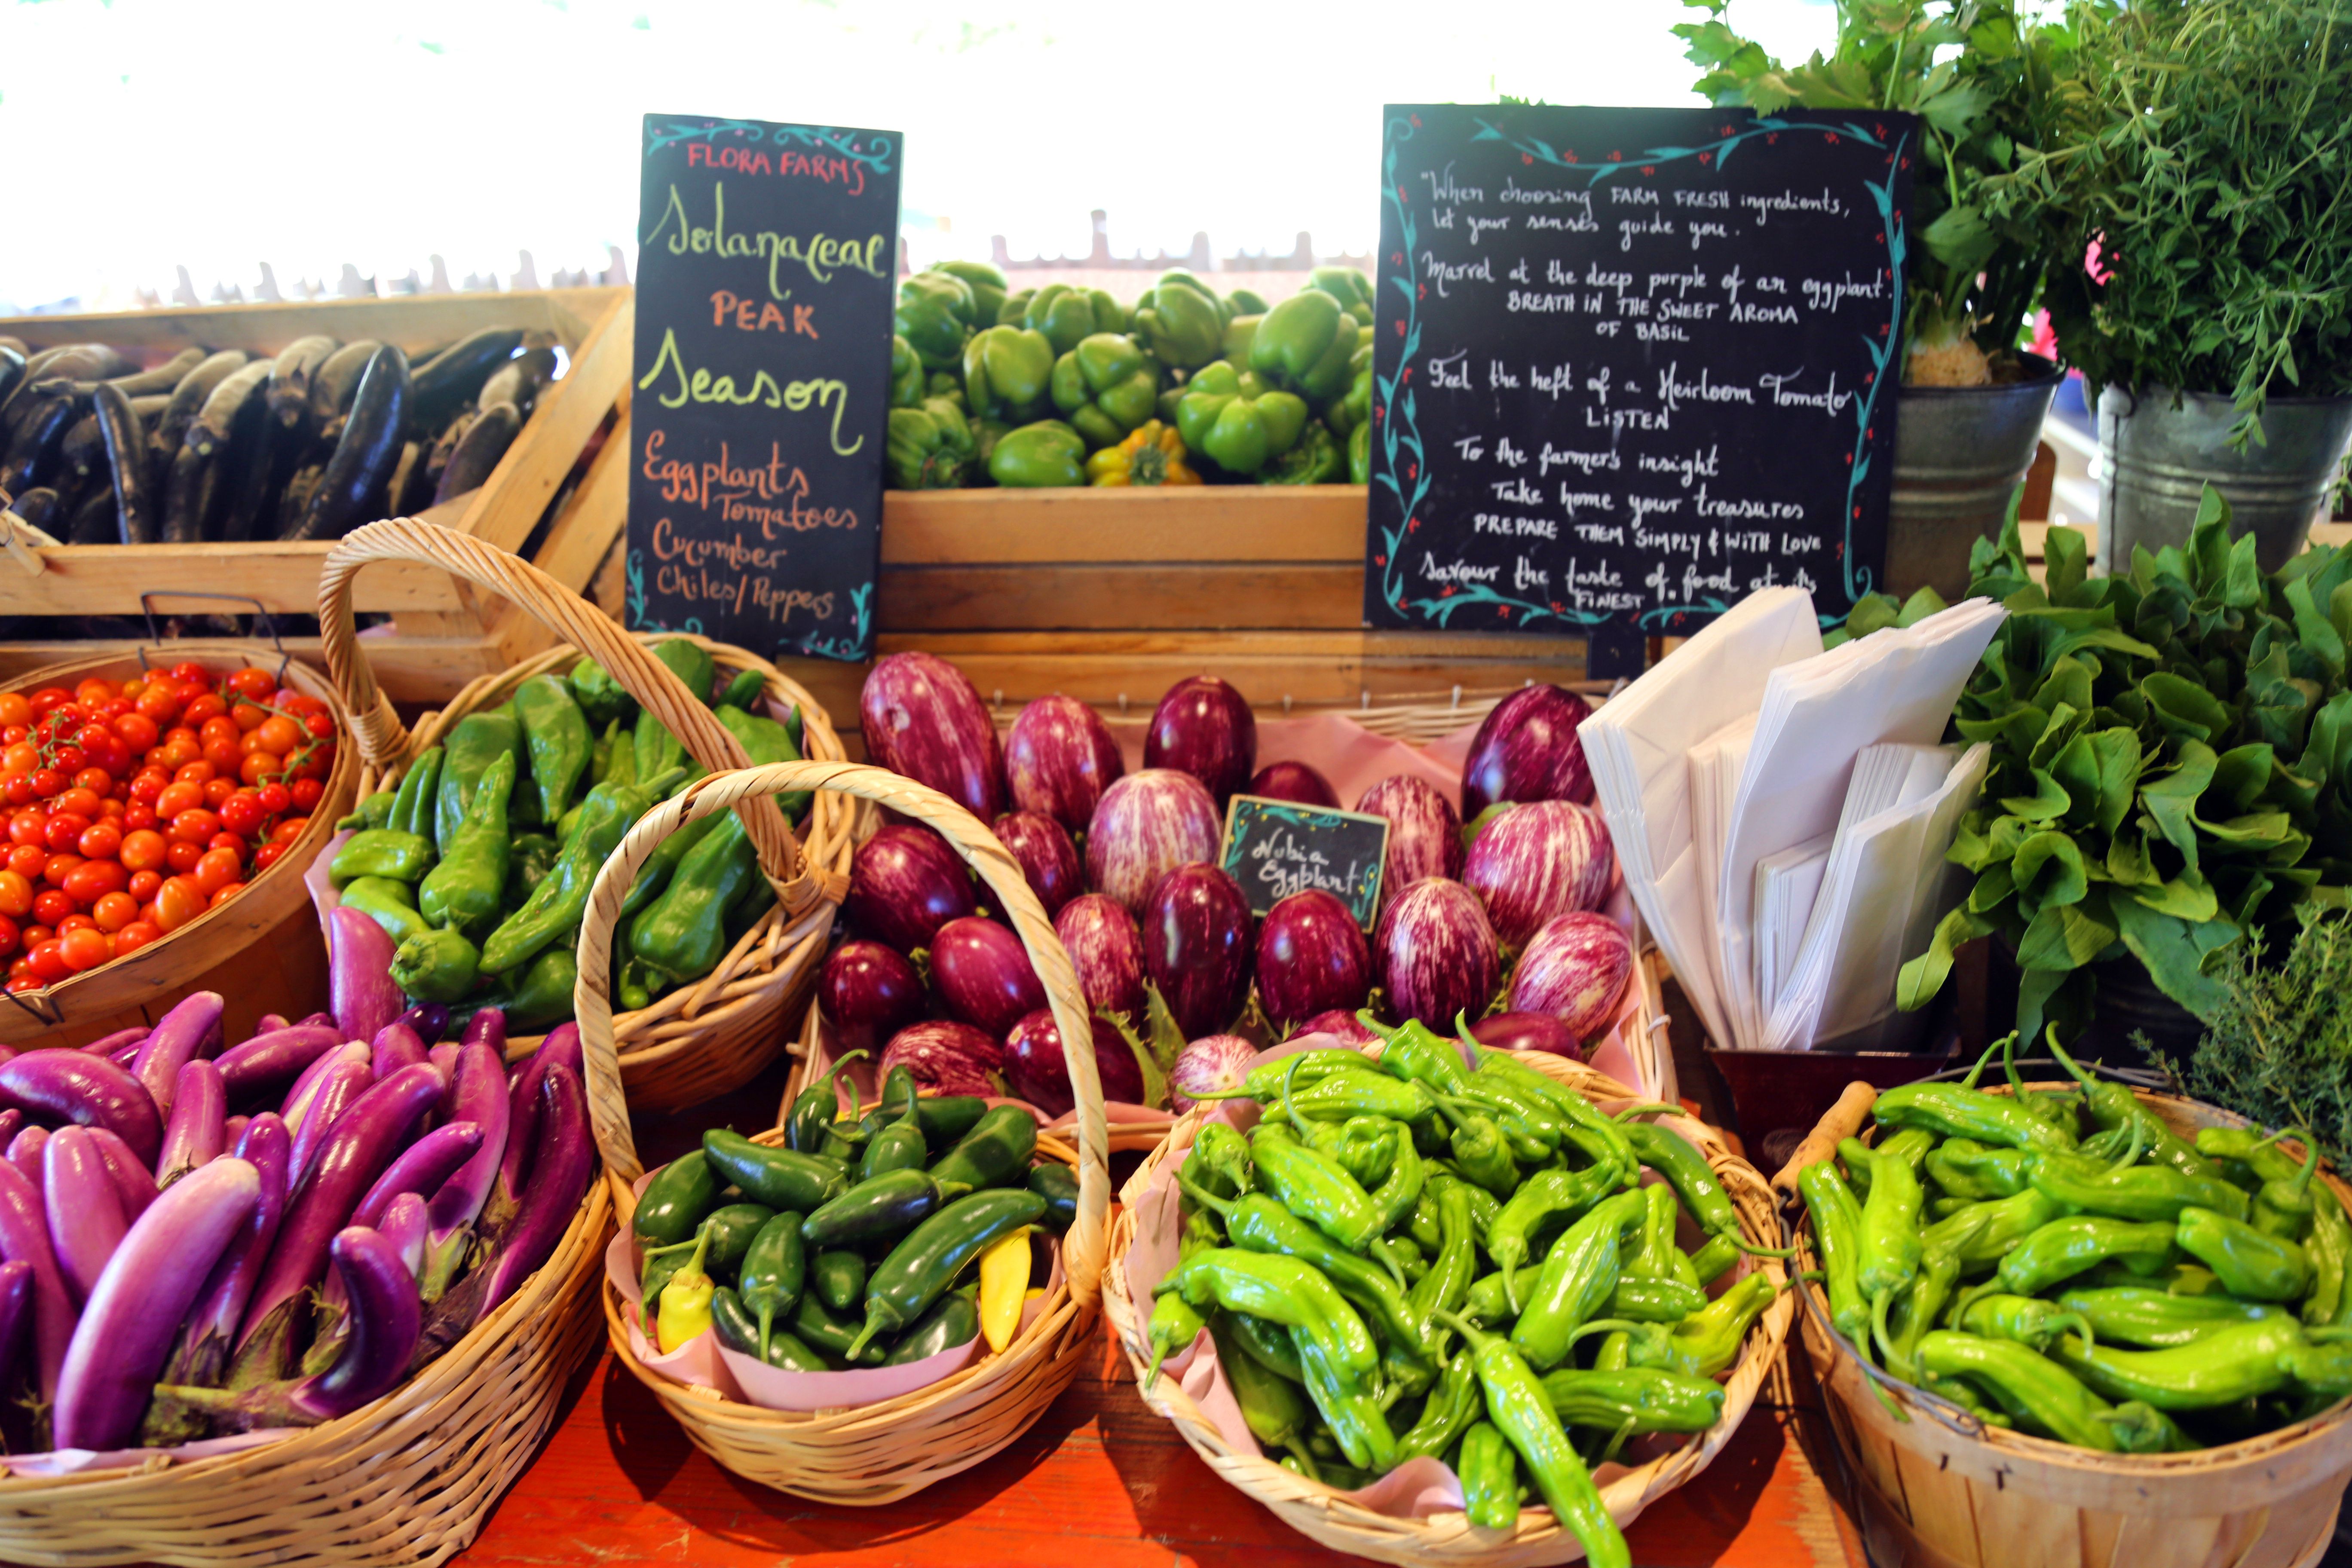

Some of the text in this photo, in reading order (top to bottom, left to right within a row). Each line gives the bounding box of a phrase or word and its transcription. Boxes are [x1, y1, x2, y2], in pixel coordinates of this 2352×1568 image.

[688, 143, 864, 196] FLORA FARMS
[1500, 176, 1592, 222] choosing
[1611, 186, 1660, 205] FARM
[1674, 190, 1730, 209] FRESH
[1467, 215, 1510, 245] your
[1526, 214, 1599, 233] senses
[1619, 211, 1674, 252] guide
[1421, 250, 1495, 298] Marvel
[1509, 257, 1531, 285] at
[1547, 259, 1577, 285] the
[1586, 261, 1632, 298] deep
[1648, 263, 1707, 299] purple
[1721, 263, 1745, 305] of
[1757, 276, 1787, 294] an
[710, 289, 819, 340] PEAK
[1507, 289, 1576, 313] BREATH
[1617, 297, 1650, 317] THE
[1656, 299, 1719, 323] SWEET
[1729, 302, 1798, 324] AROMA
[1596, 320, 1622, 338] OF
[638, 327, 864, 456] Season
[1428, 349, 1852, 417] Feel the heft of a Heirloom Tomato
[643, 429, 810, 511] Eggplants
[1454, 435, 1485, 461] To
[1496, 436, 1528, 468] the
[1638, 444, 1719, 488] insight
[714, 490, 858, 540] Tomatoes
[1491, 477, 1804, 530] Take home your treasures
[653, 518, 788, 570] Cucumber
[1473, 513, 1559, 540] PREPARE
[1574, 523, 1624, 547] THEM
[1420, 550, 1501, 584] Savour
[1513, 555, 1550, 591] the
[1565, 556, 1623, 594] taste
[1645, 561, 1670, 604] of
[1681, 563, 1740, 603] food
[1749, 562, 1780, 591] at
[1251, 826, 1329, 866] Nubia
[1258, 859, 1361, 898] Eggplant
